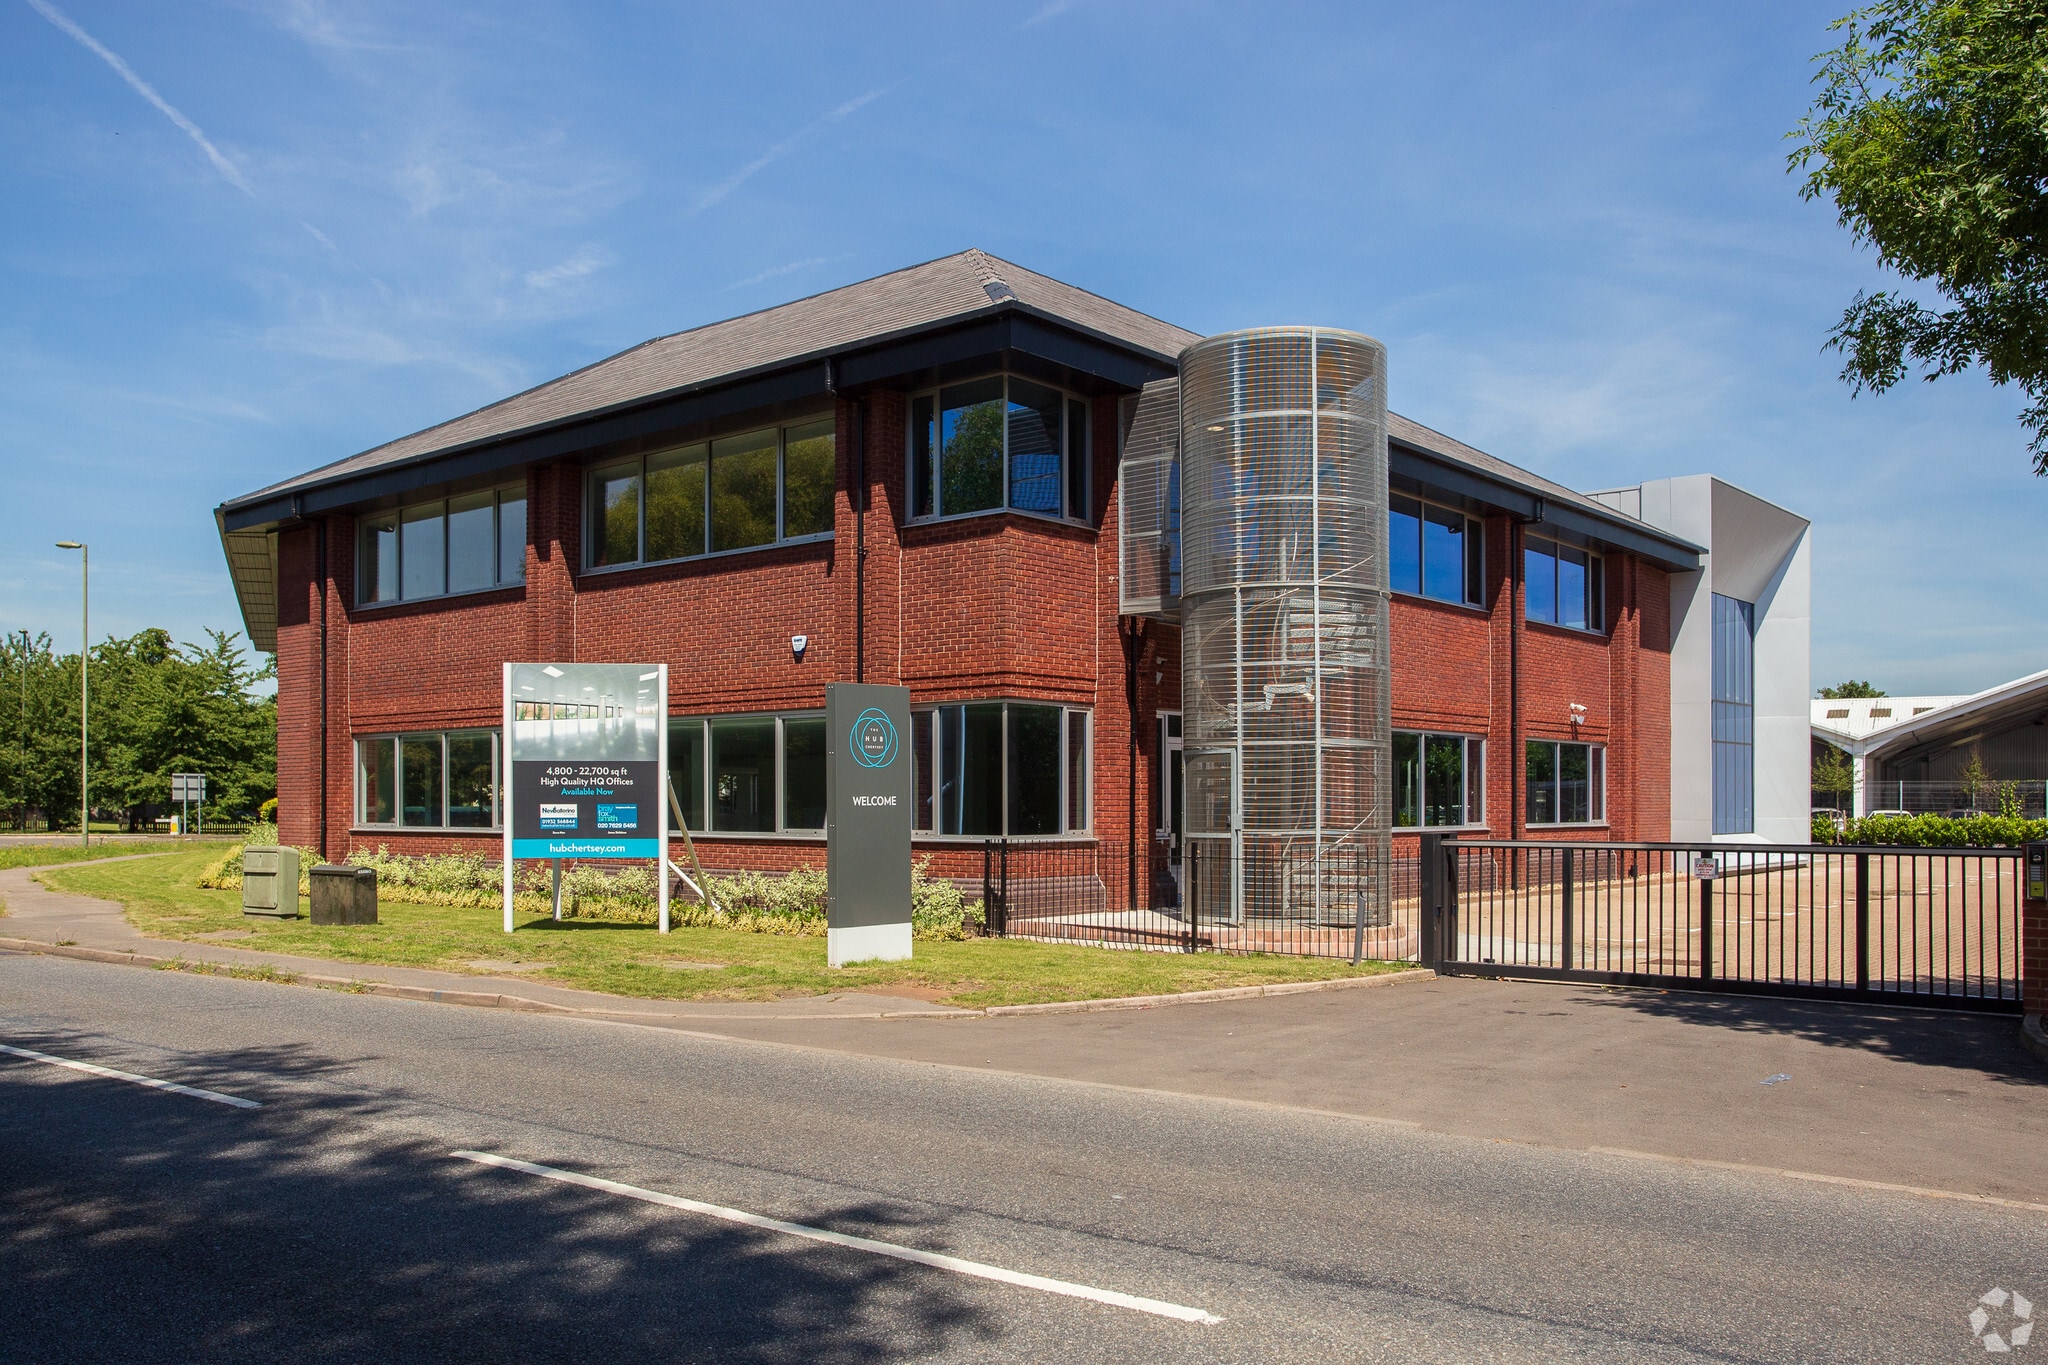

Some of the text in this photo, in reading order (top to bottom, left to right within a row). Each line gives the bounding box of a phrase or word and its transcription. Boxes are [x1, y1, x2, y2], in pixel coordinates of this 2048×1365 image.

[546, 767, 573, 776] 4,800
[579, 767, 609, 776] 22,700
[611, 769, 619, 777] sq
[621, 767, 627, 775] ft
[540, 777, 634, 787] High Quality HQ Offices
[561, 787, 614, 796] Available Now
[852, 796, 897, 806] WELCOME
[549, 843, 626, 854] hubchertsey.com
